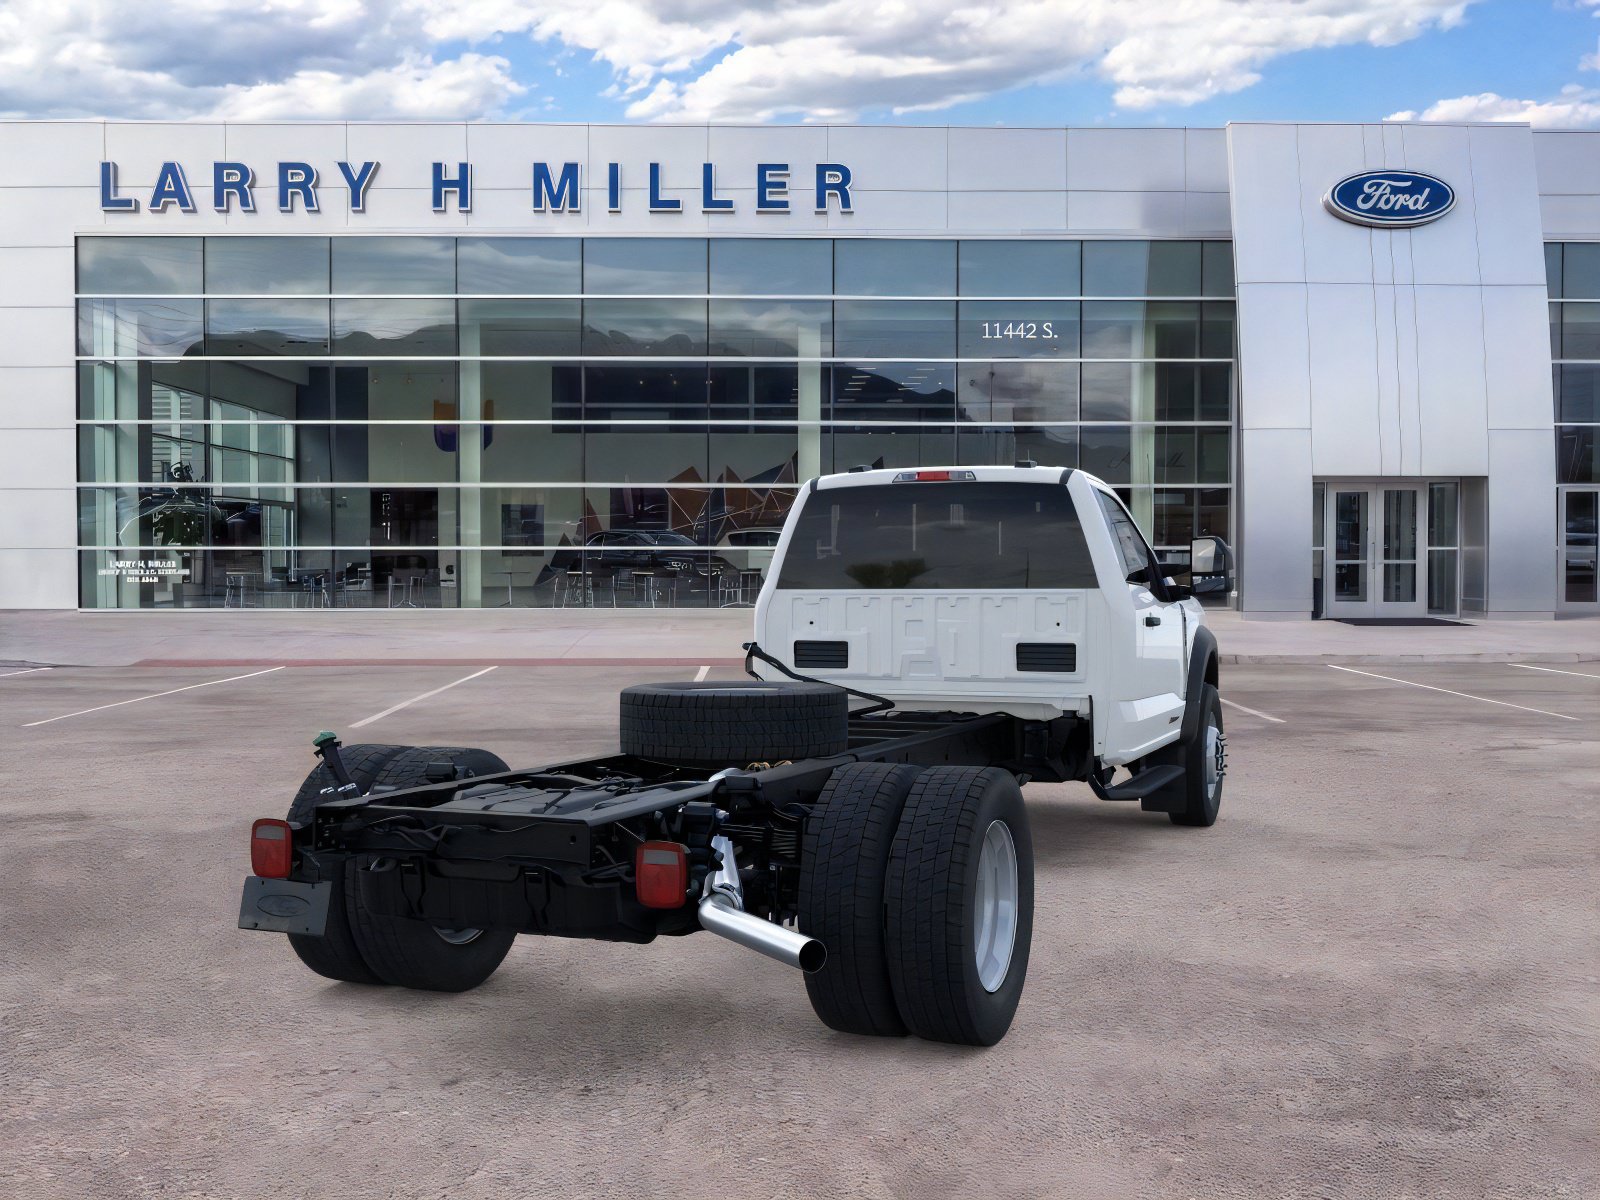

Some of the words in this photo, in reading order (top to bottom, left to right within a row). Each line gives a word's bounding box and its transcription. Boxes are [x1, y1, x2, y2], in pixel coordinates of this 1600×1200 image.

[100, 161, 380, 214] LARRY
[432, 162, 473, 214] H
[532, 162, 855, 215] MILLER
[1356, 179, 1431, 211] Ford
[982, 322, 1038, 339] 11442
[1042, 322, 1059, 339] S.
